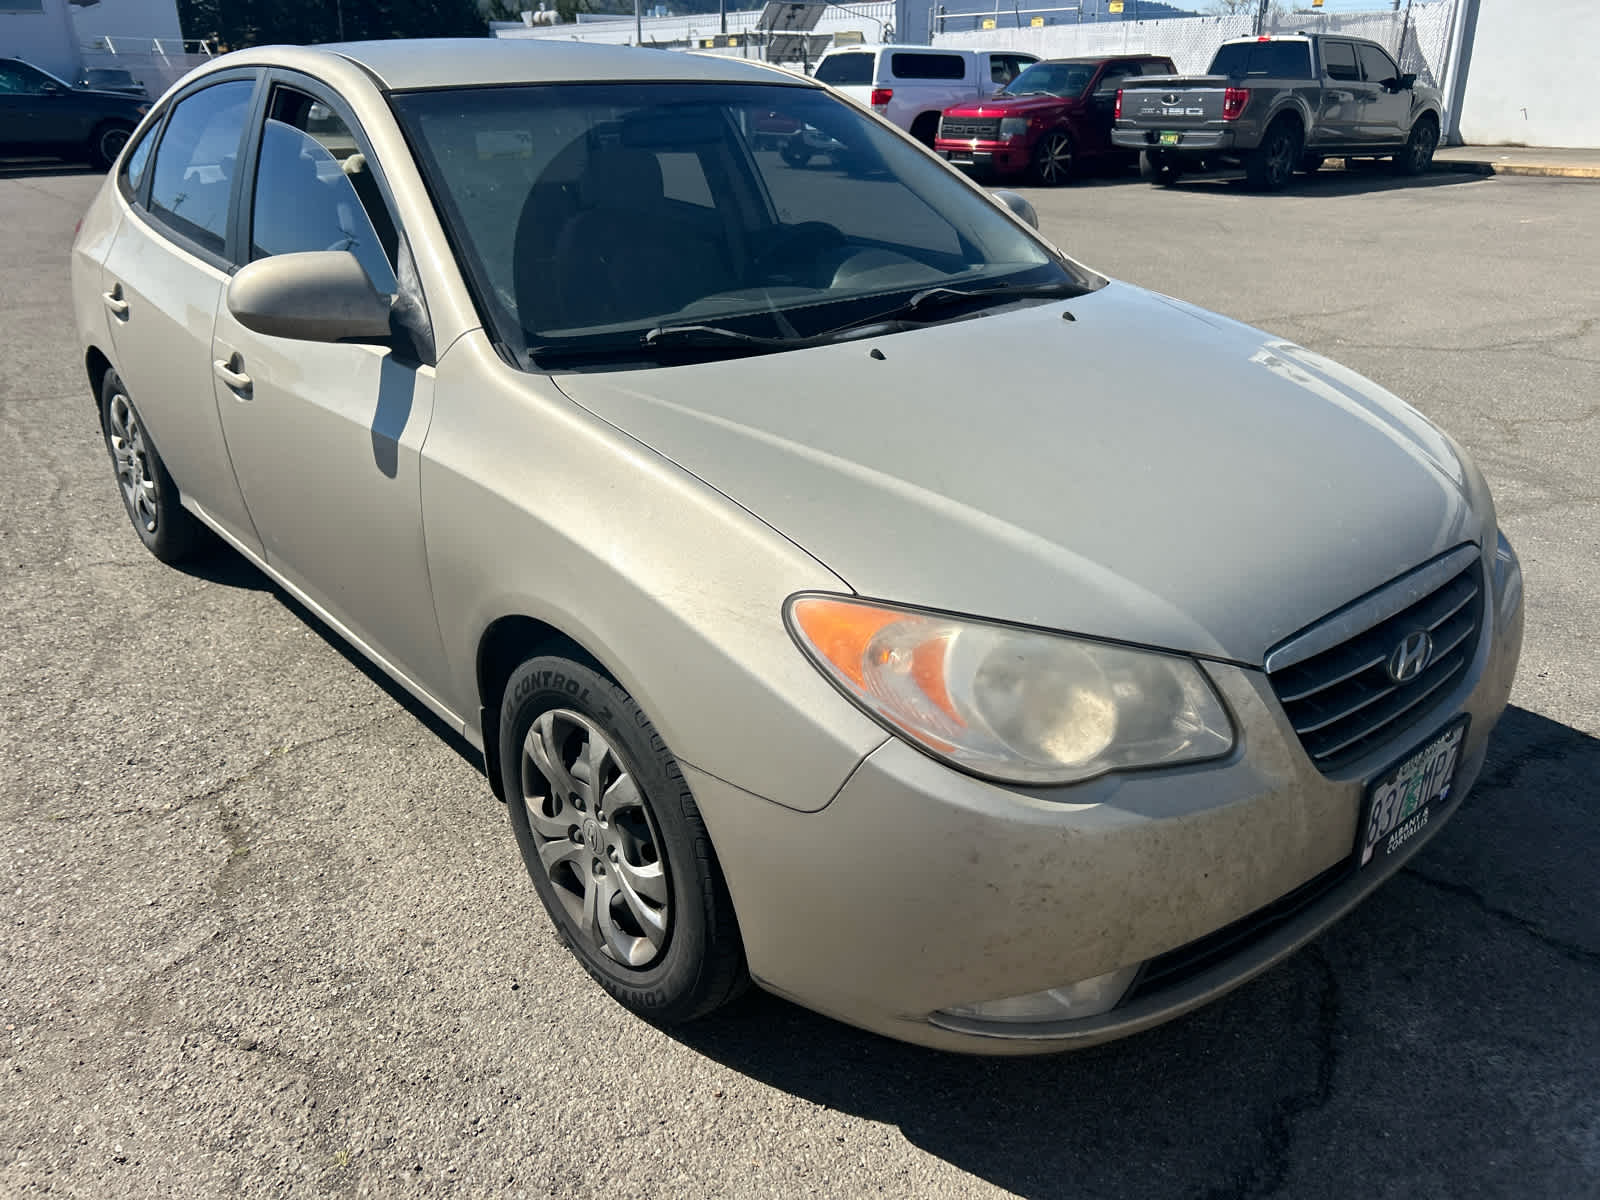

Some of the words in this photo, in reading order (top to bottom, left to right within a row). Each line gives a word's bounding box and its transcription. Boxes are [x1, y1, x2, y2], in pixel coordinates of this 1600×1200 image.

[942, 124, 993, 136] FORD
[514, 671, 590, 705] CONTROL
[1367, 779, 1409, 846] 837
